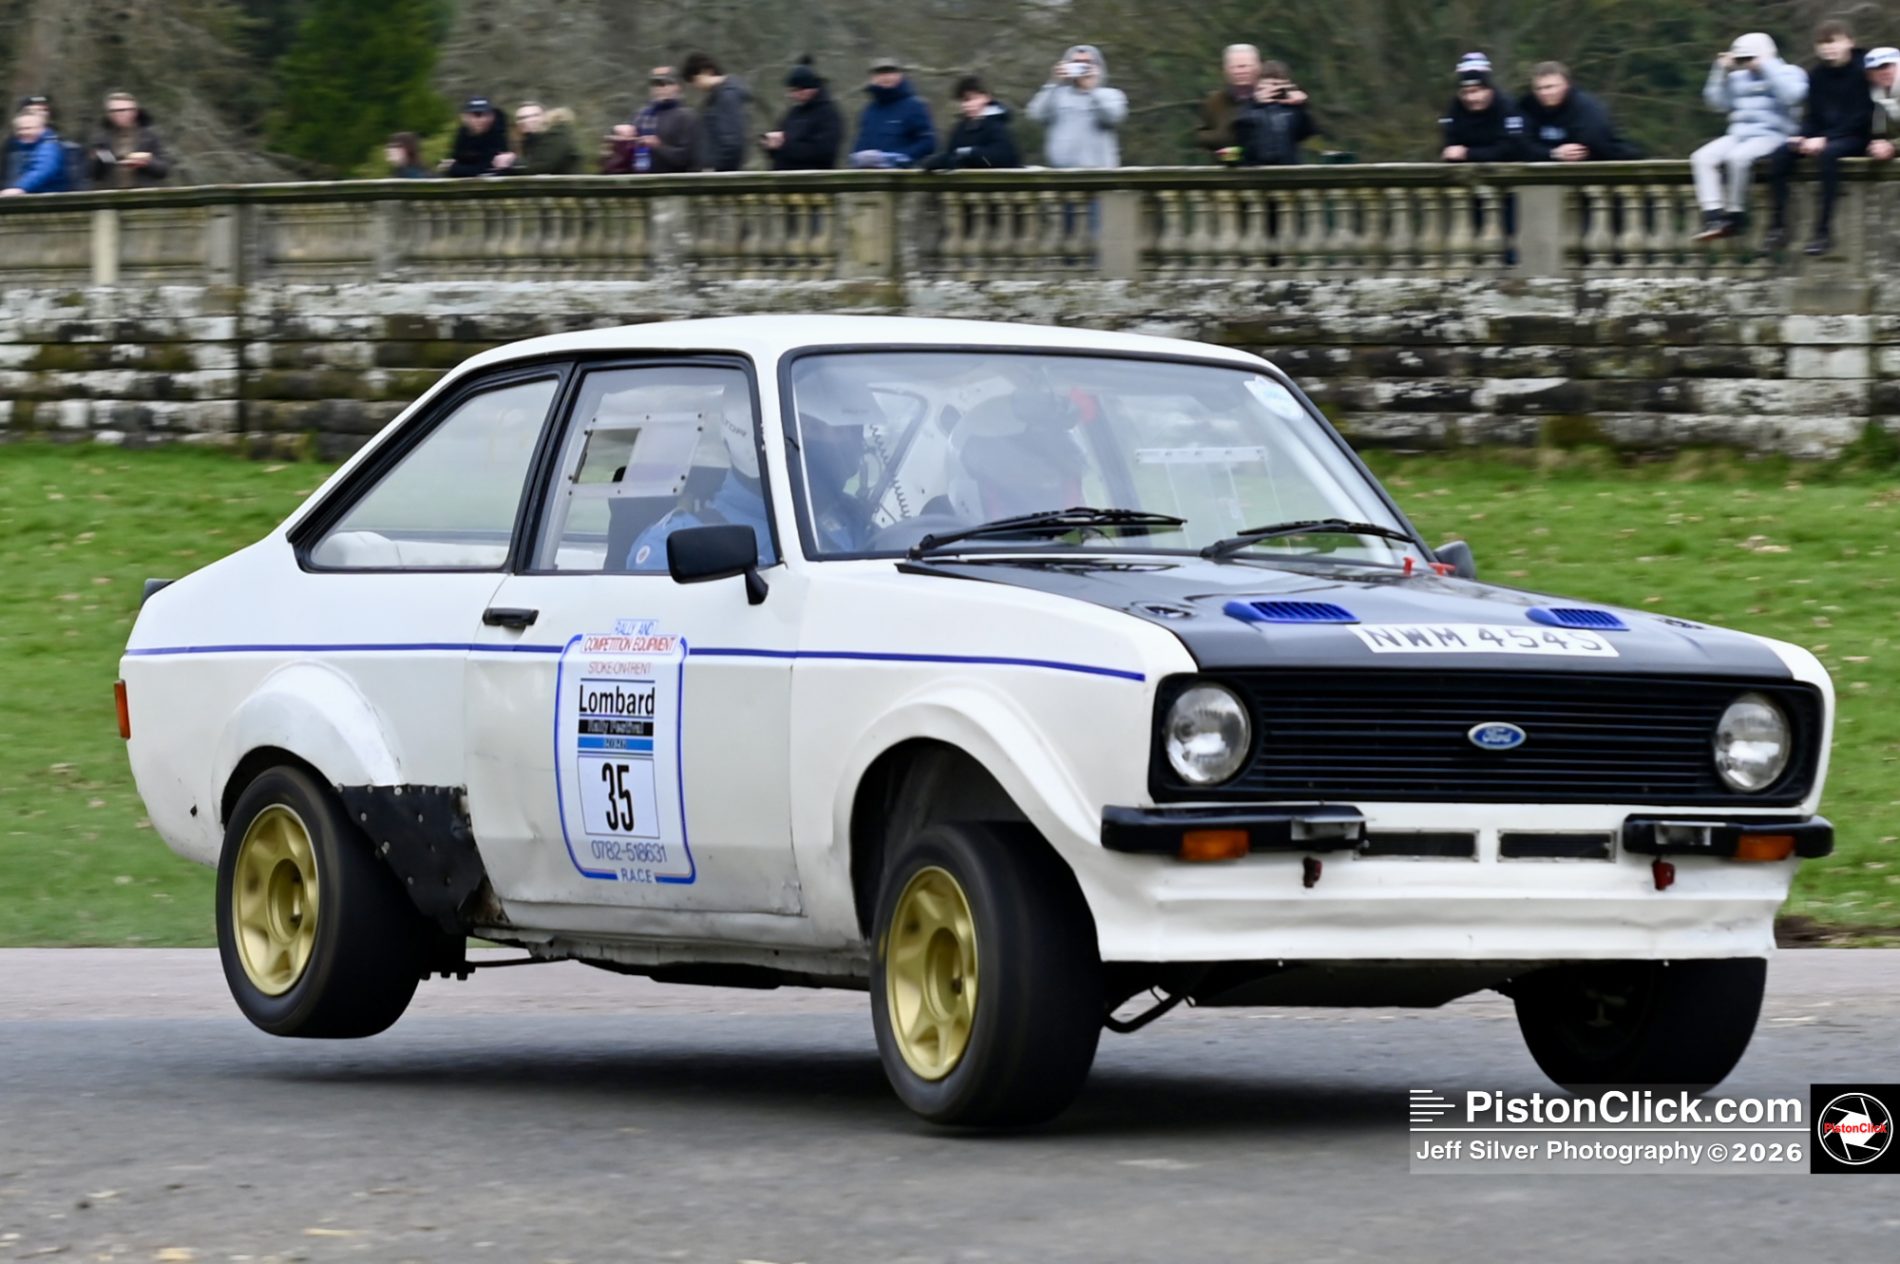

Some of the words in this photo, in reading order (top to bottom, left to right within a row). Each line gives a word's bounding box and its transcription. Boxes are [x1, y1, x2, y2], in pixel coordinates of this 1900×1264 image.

[1364, 627, 1468, 648] NWM
[579, 684, 656, 715] Lombard
[601, 762, 634, 832] 35
[620, 867, 653, 883] RACE
